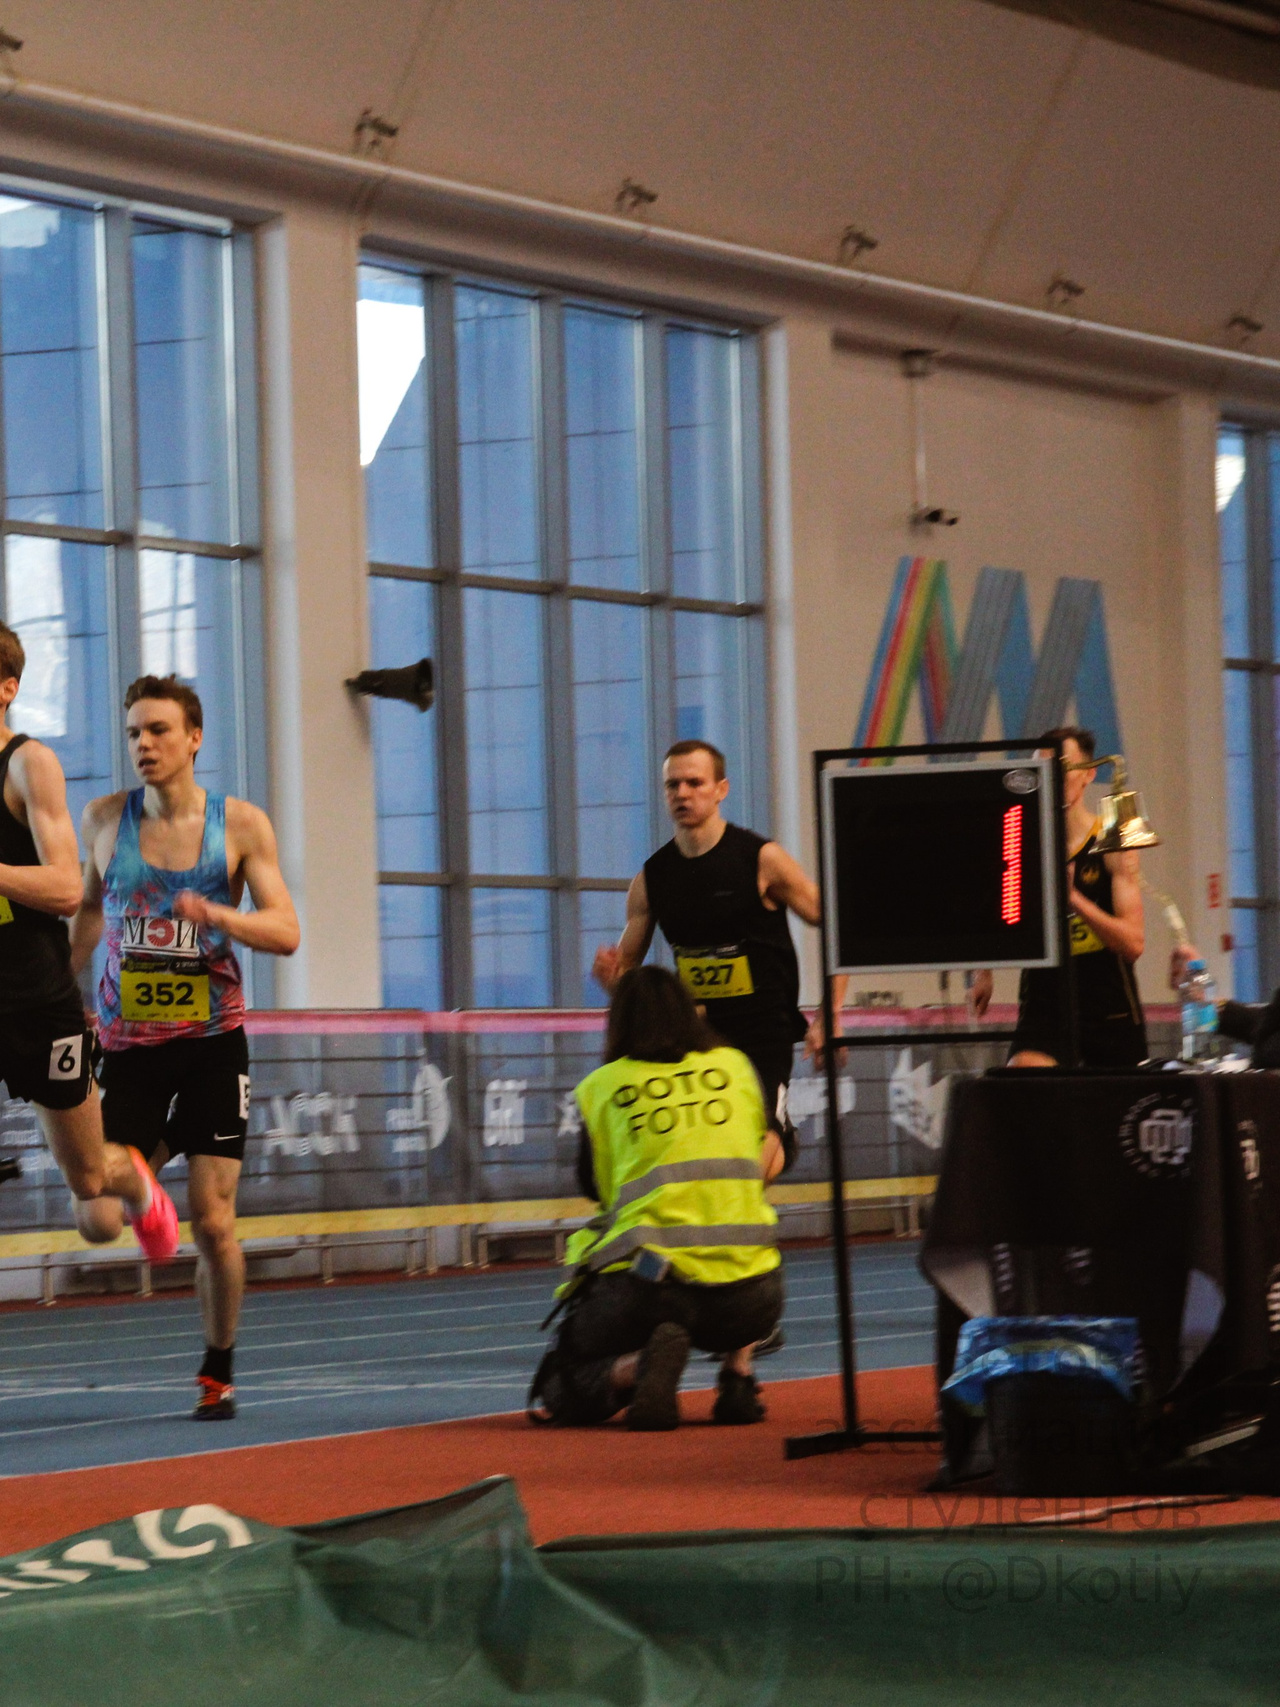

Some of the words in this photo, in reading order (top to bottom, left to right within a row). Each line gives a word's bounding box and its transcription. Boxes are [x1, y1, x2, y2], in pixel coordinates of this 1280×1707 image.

[690, 964, 734, 986] 327
[135, 982, 194, 1006] 352
[57, 1045, 75, 1073] 6
[611, 1067, 729, 1108] ФОТО
[628, 1098, 733, 1143] FOTO
